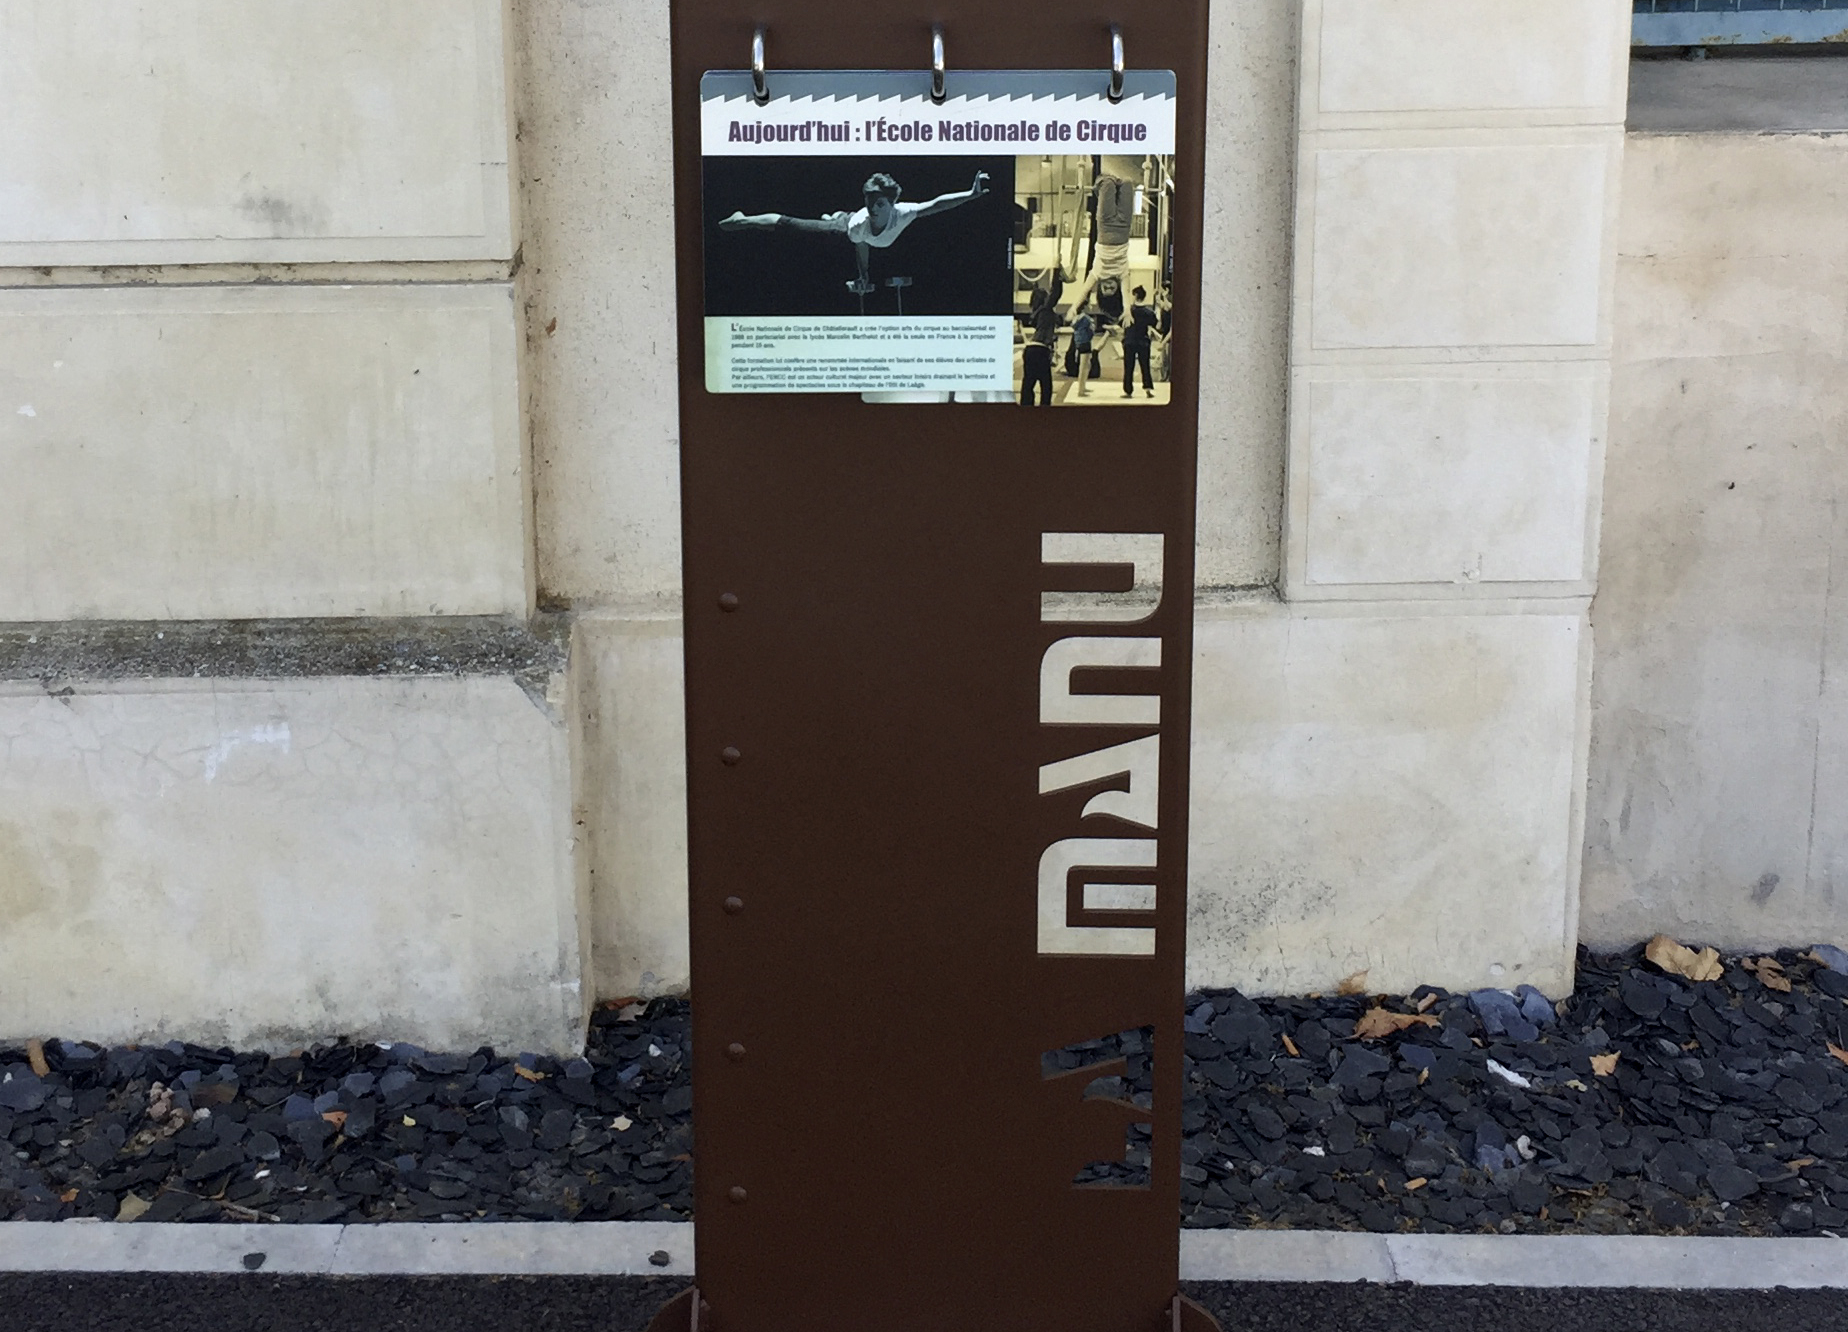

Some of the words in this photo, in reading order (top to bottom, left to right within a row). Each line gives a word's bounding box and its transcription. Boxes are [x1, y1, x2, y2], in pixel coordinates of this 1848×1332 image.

[728, 120, 849, 144] Aujourd'hui
[865, 116, 932, 141] l'École
[938, 120, 1039, 141] Nationale
[1045, 120, 1070, 141] de
[1076, 120, 1146, 143] Cirque
[1037, 532, 1164, 956] MANU
[1041, 1024, 1154, 1190] LA
